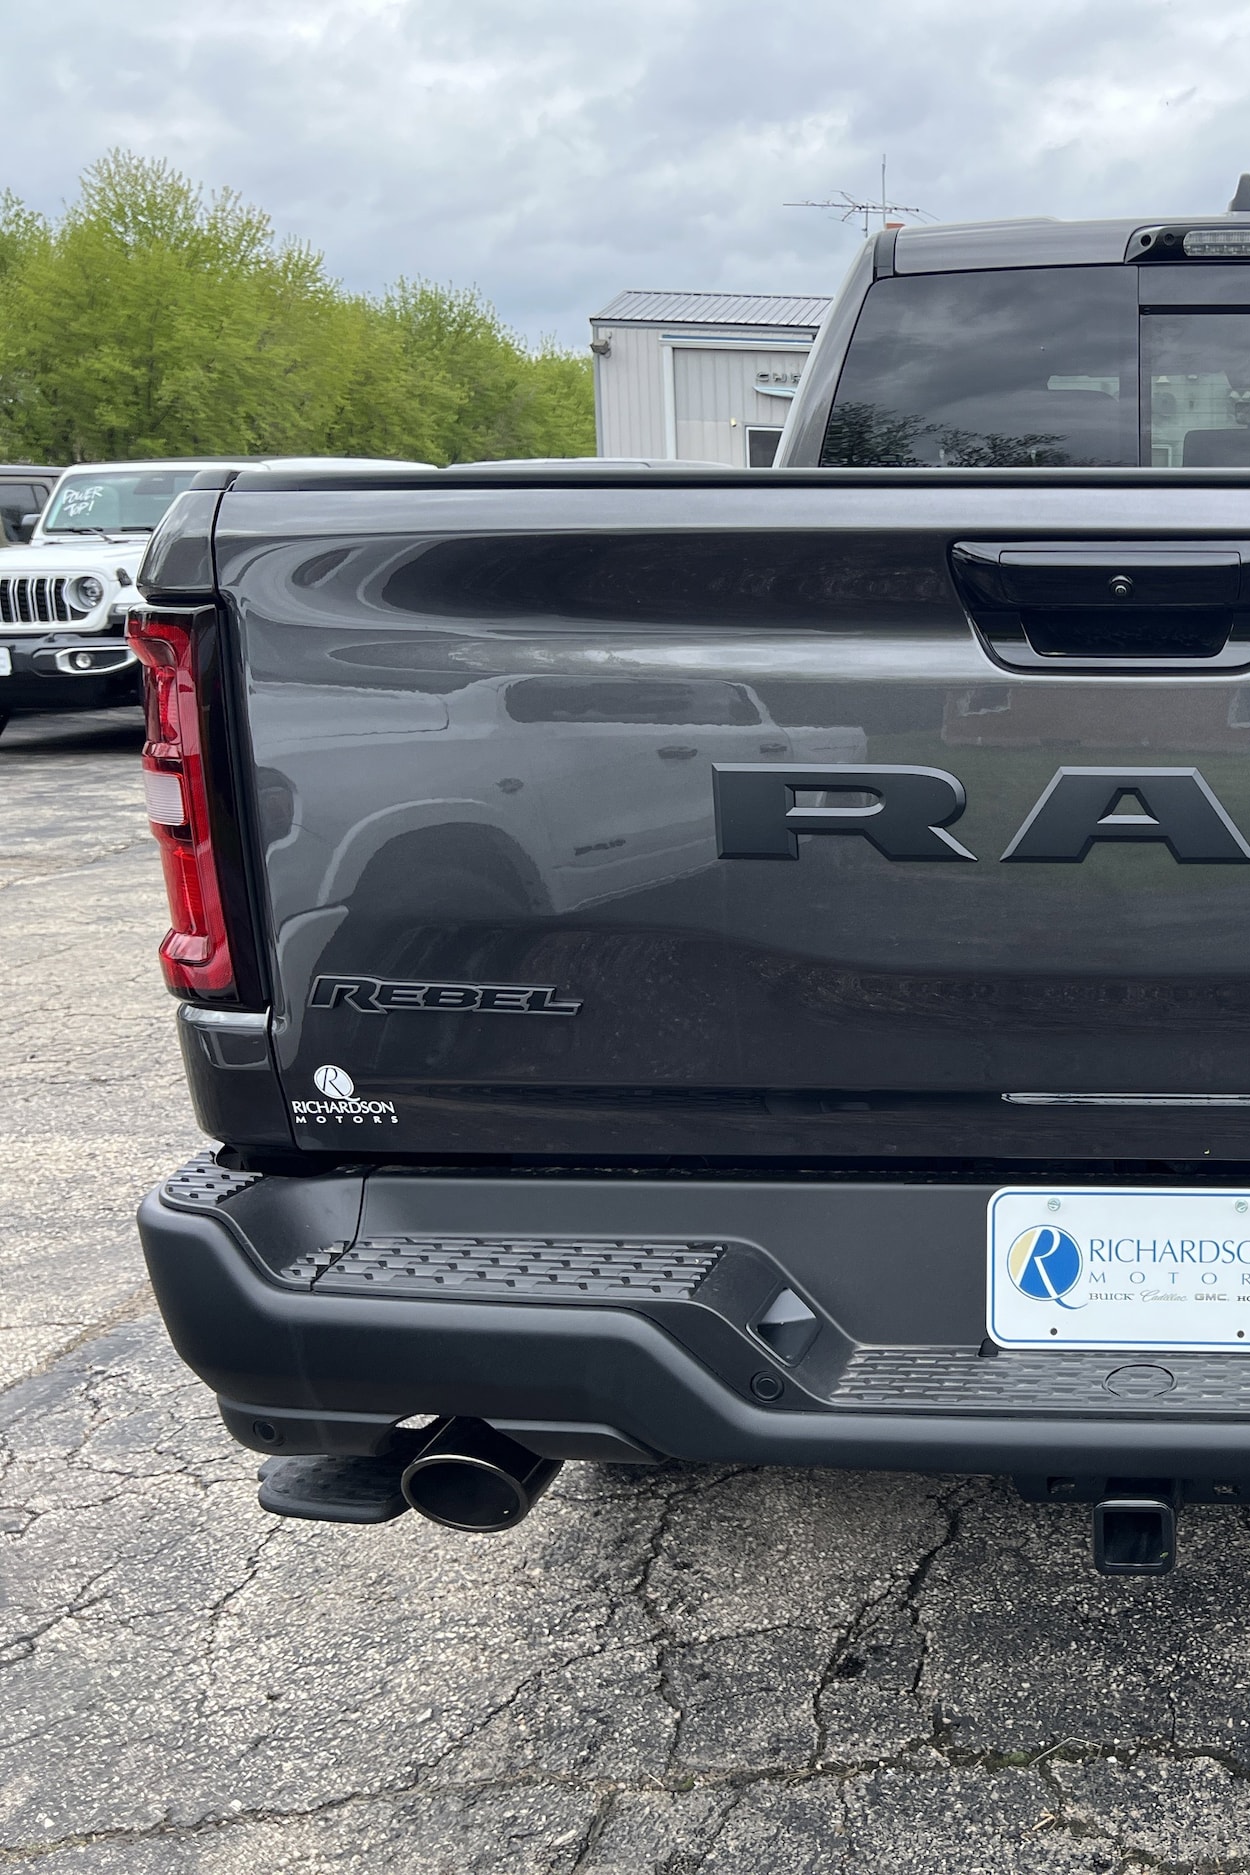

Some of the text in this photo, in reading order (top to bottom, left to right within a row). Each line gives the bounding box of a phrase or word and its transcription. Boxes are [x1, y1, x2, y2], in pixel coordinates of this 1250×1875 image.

[62, 486, 104, 504] POWER
[63, 500, 95, 517] TOP!
[310, 975, 584, 1016] REBEL
[291, 1100, 395, 1114] RICHARDSON
[295, 1115, 399, 1124] MOTORS
[1089, 1293, 1134, 1301] BUICK
[1194, 1293, 1228, 1302] GMC
